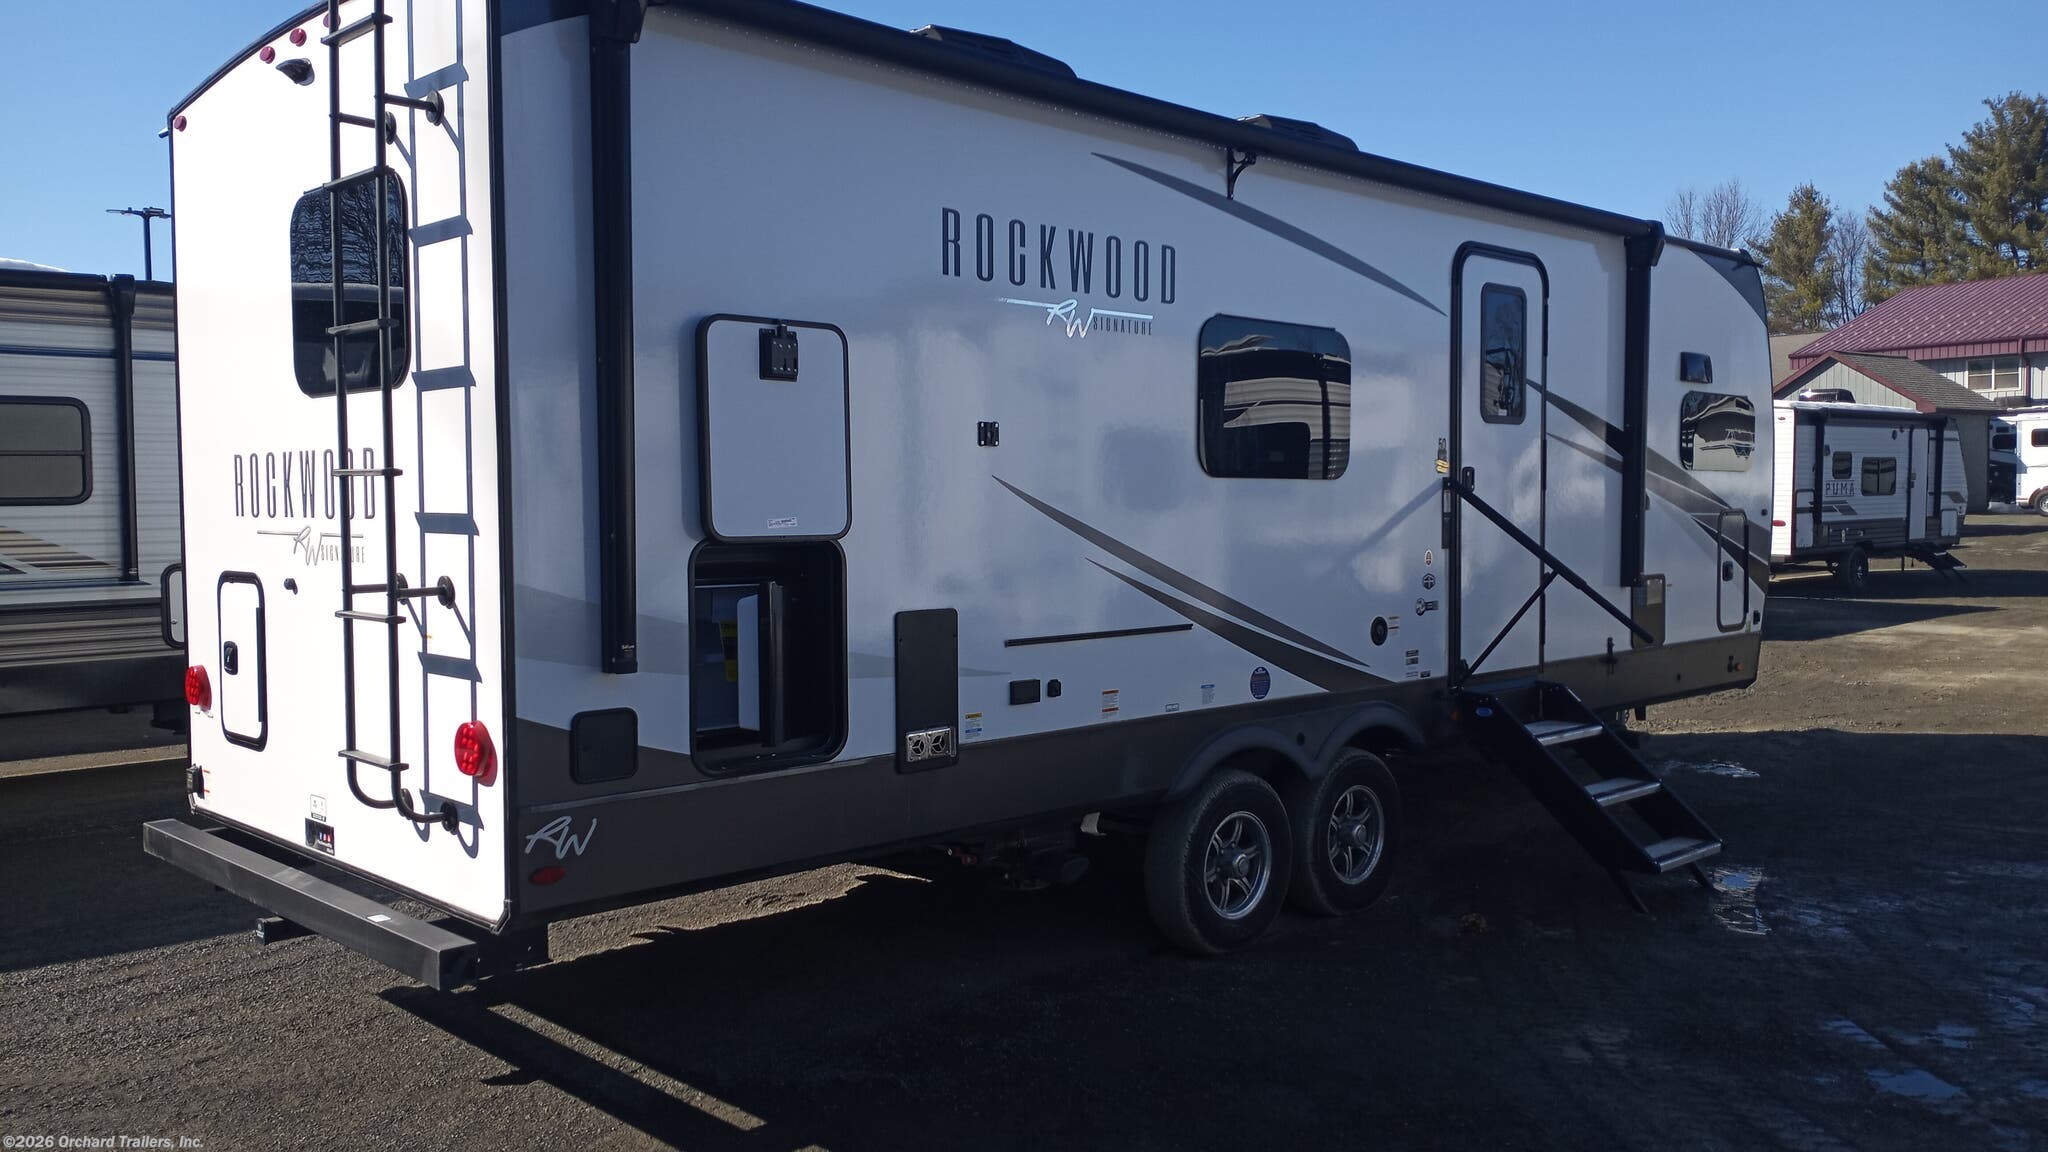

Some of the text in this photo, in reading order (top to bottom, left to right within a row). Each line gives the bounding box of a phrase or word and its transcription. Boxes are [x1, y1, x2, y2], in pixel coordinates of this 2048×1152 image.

[942, 207, 1176, 304] ROCKWOOD
[1093, 316, 1153, 335] SIGNATURE
[1825, 482, 1855, 496] PUMA
[524, 815, 598, 860] RW
